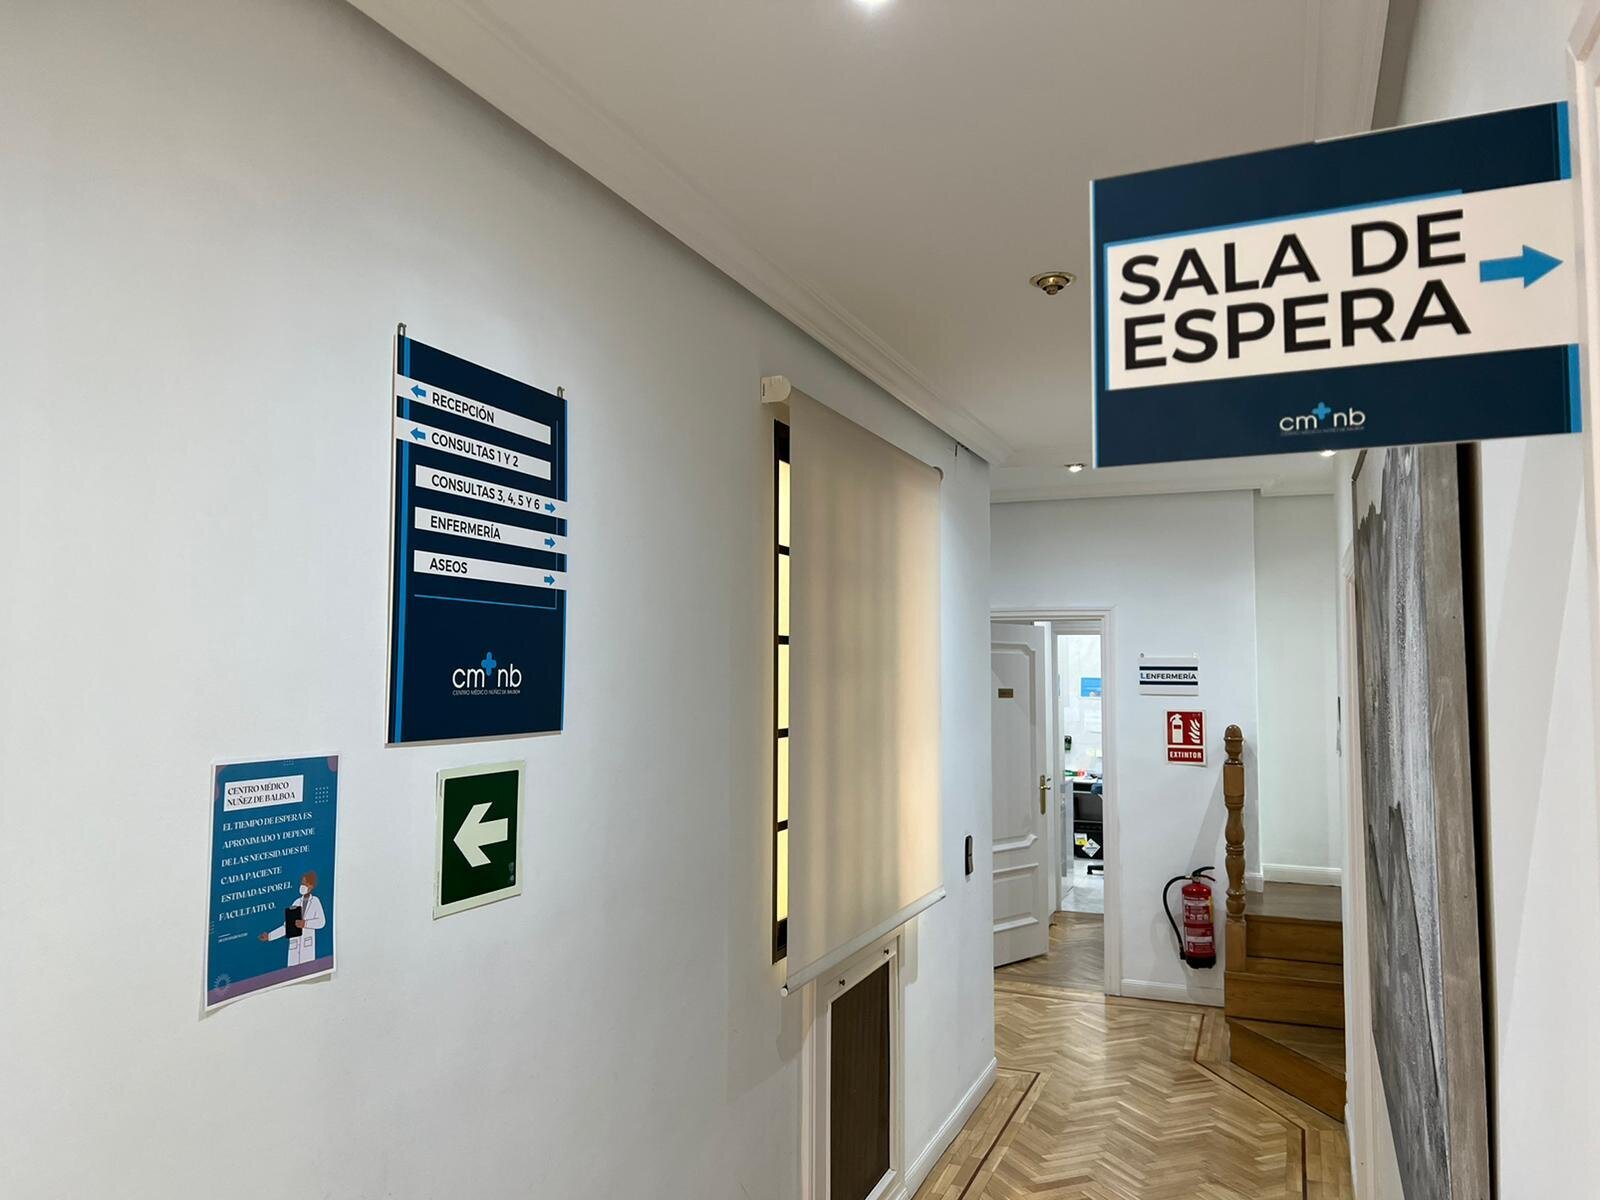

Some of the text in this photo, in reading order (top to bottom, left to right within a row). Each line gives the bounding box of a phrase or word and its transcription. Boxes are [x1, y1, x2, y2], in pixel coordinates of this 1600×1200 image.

[1120, 208, 1466, 305] SALA DE
[1124, 278, 1471, 370] ESPERA
[432, 392, 494, 423] RECEPCIÓN
[431, 432, 519, 467] CONSULTAS 1 Y 2
[431, 474, 540, 510] CONSULTAS 3, 4, 5 Y 6
[430, 515, 501, 539] ENFERMERÍA
[429, 558, 468, 574] ASEOS
[1169, 751, 1202, 759] EXTINTOR
[227, 782, 289, 795] CENTRO MÉDICO
[253, 796, 265, 804] DE
[265, 792, 296, 802] BALBOA
[223, 811, 313, 831] EL TIEMPO DE ESPERA ES
[223, 827, 315, 849] APROXIMADO Y DEPENDE
[221, 845, 310, 867] DE LAS NECESIDADES DE
[220, 866, 282, 885] CADA PACIENTE
[221, 881, 293, 903] ESTIMADAS POR EL
